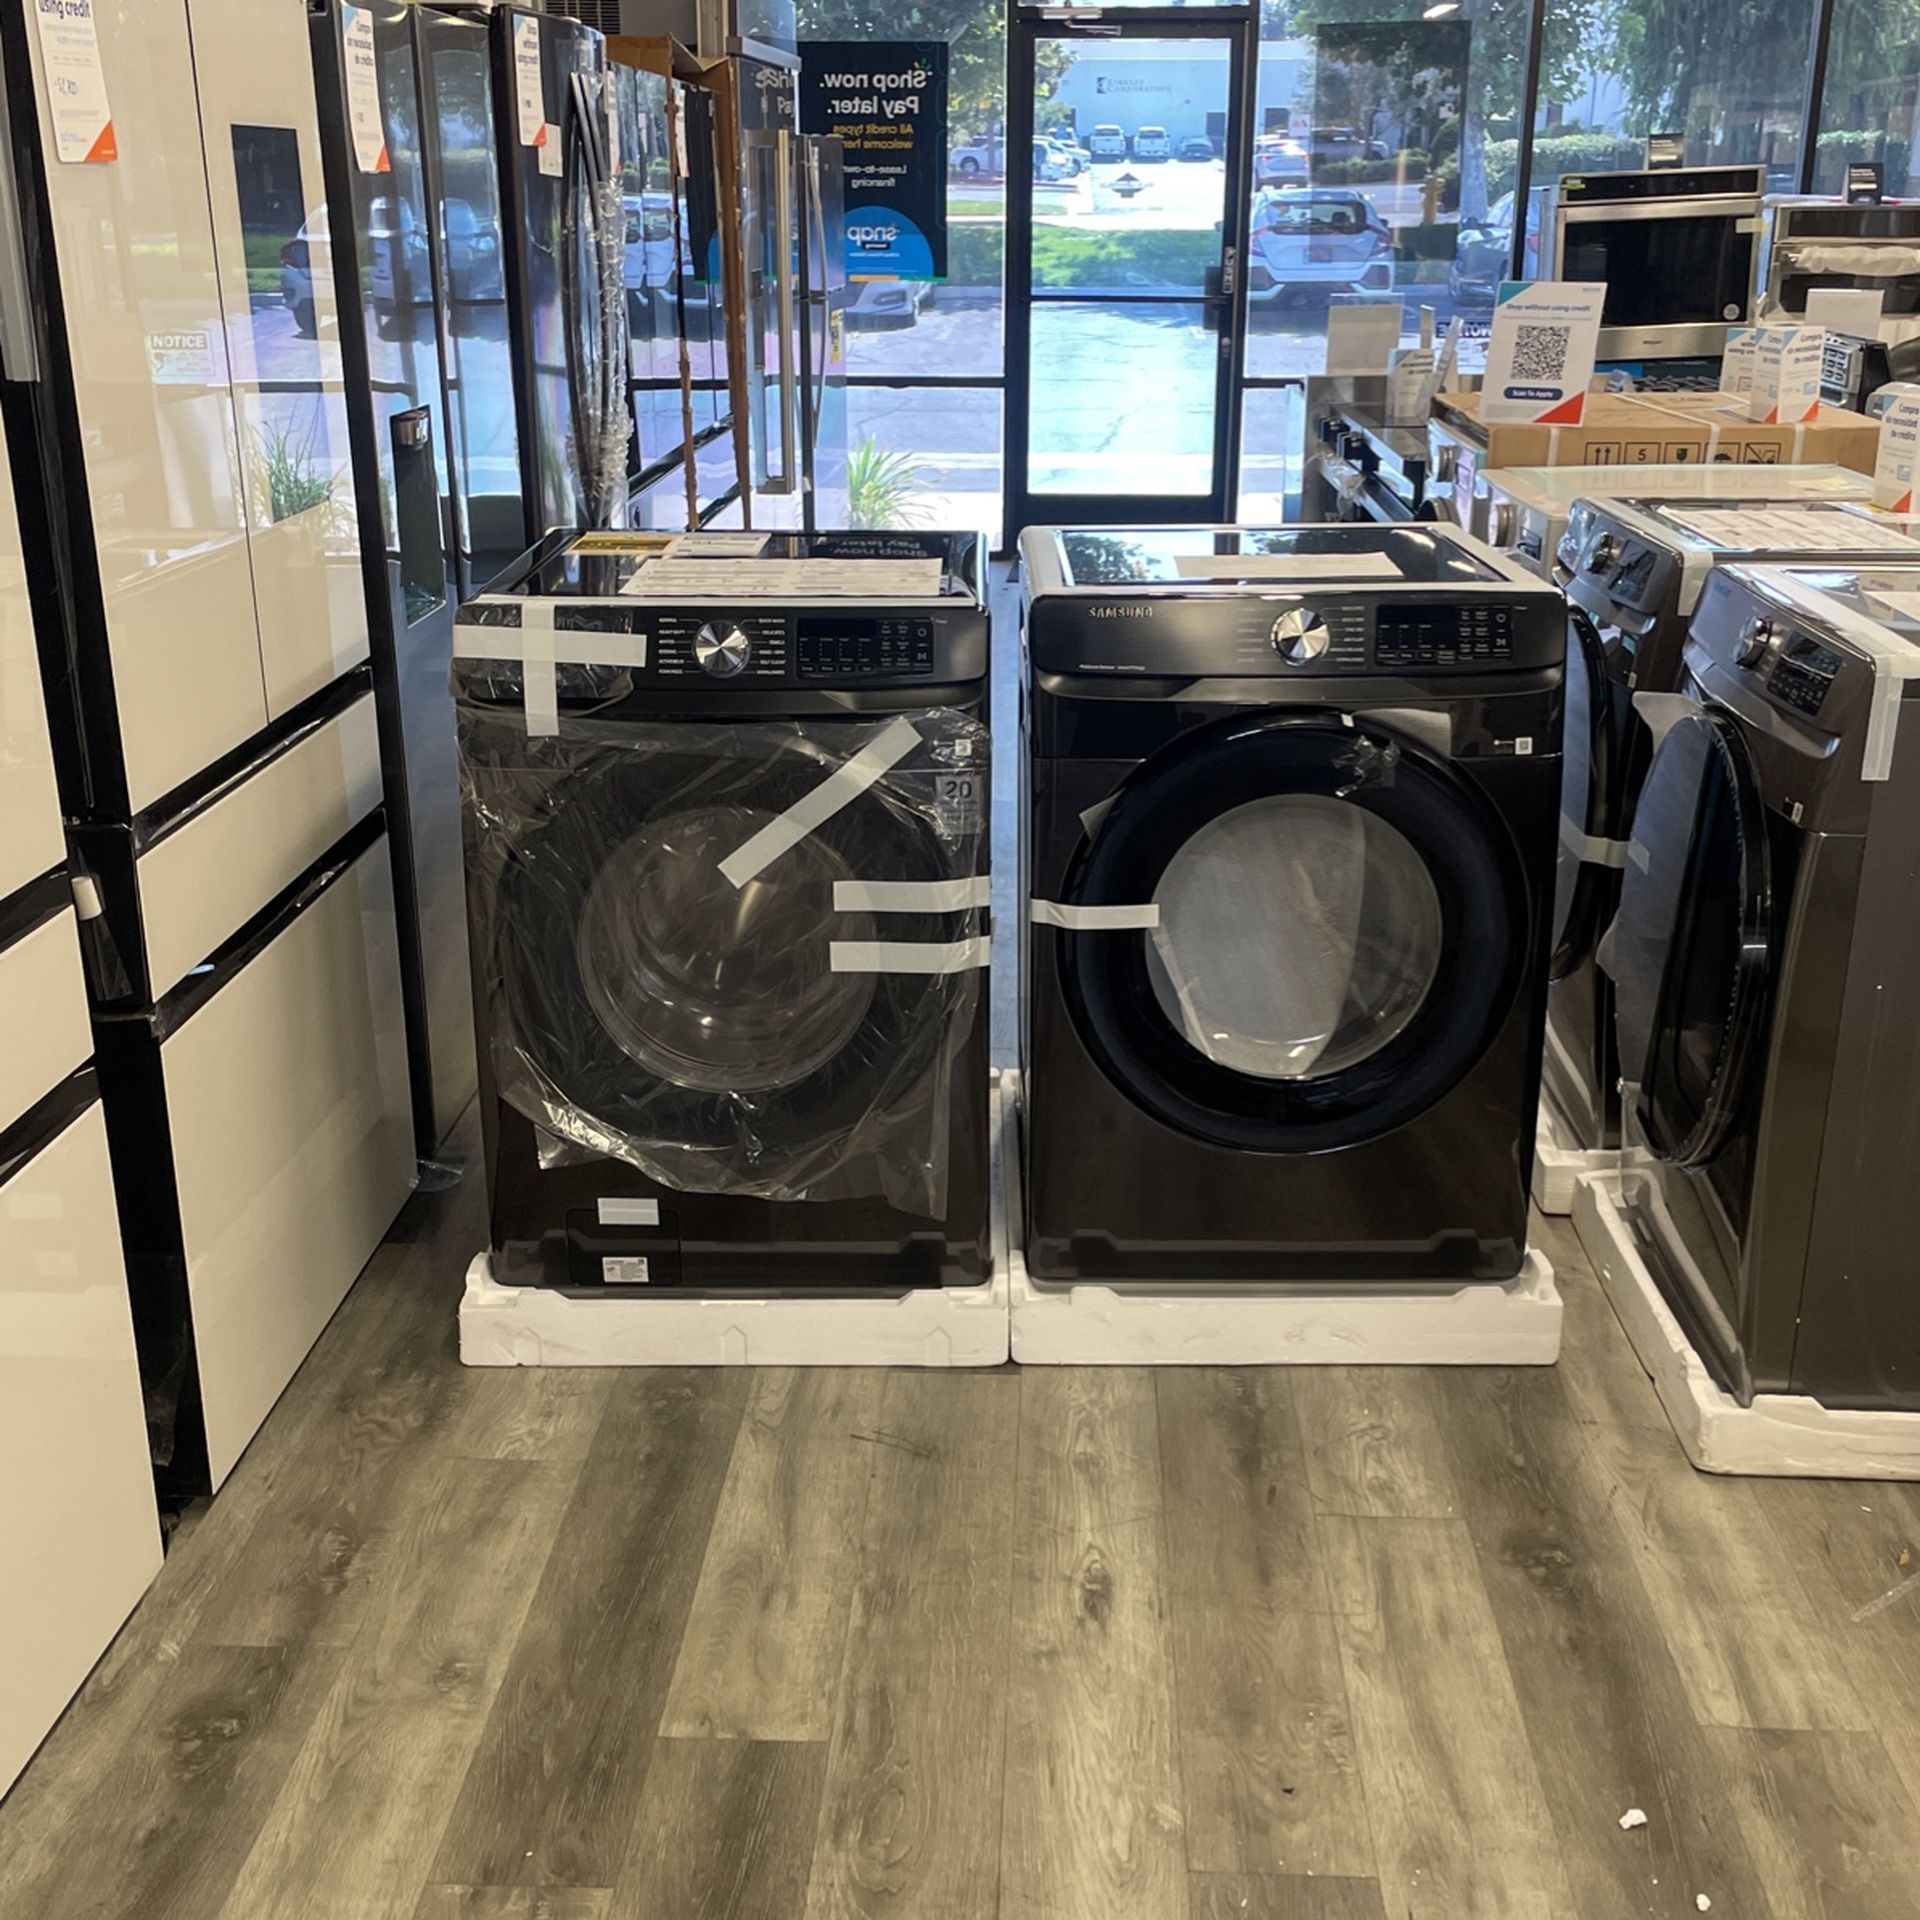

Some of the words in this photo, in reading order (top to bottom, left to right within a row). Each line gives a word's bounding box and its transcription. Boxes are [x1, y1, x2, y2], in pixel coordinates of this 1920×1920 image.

[65, 0, 91, 18] credit
[1525, 303, 1550, 311] without
[153, 335, 204, 348] NOTICE
[1535, 390, 1554, 398] Apply
[1899, 403, 1919, 415] Compra
[1638, 448, 1647, 461] 5
[1088, 607, 1153, 618] SAMSUNG
[945, 781, 972, 799] 20
